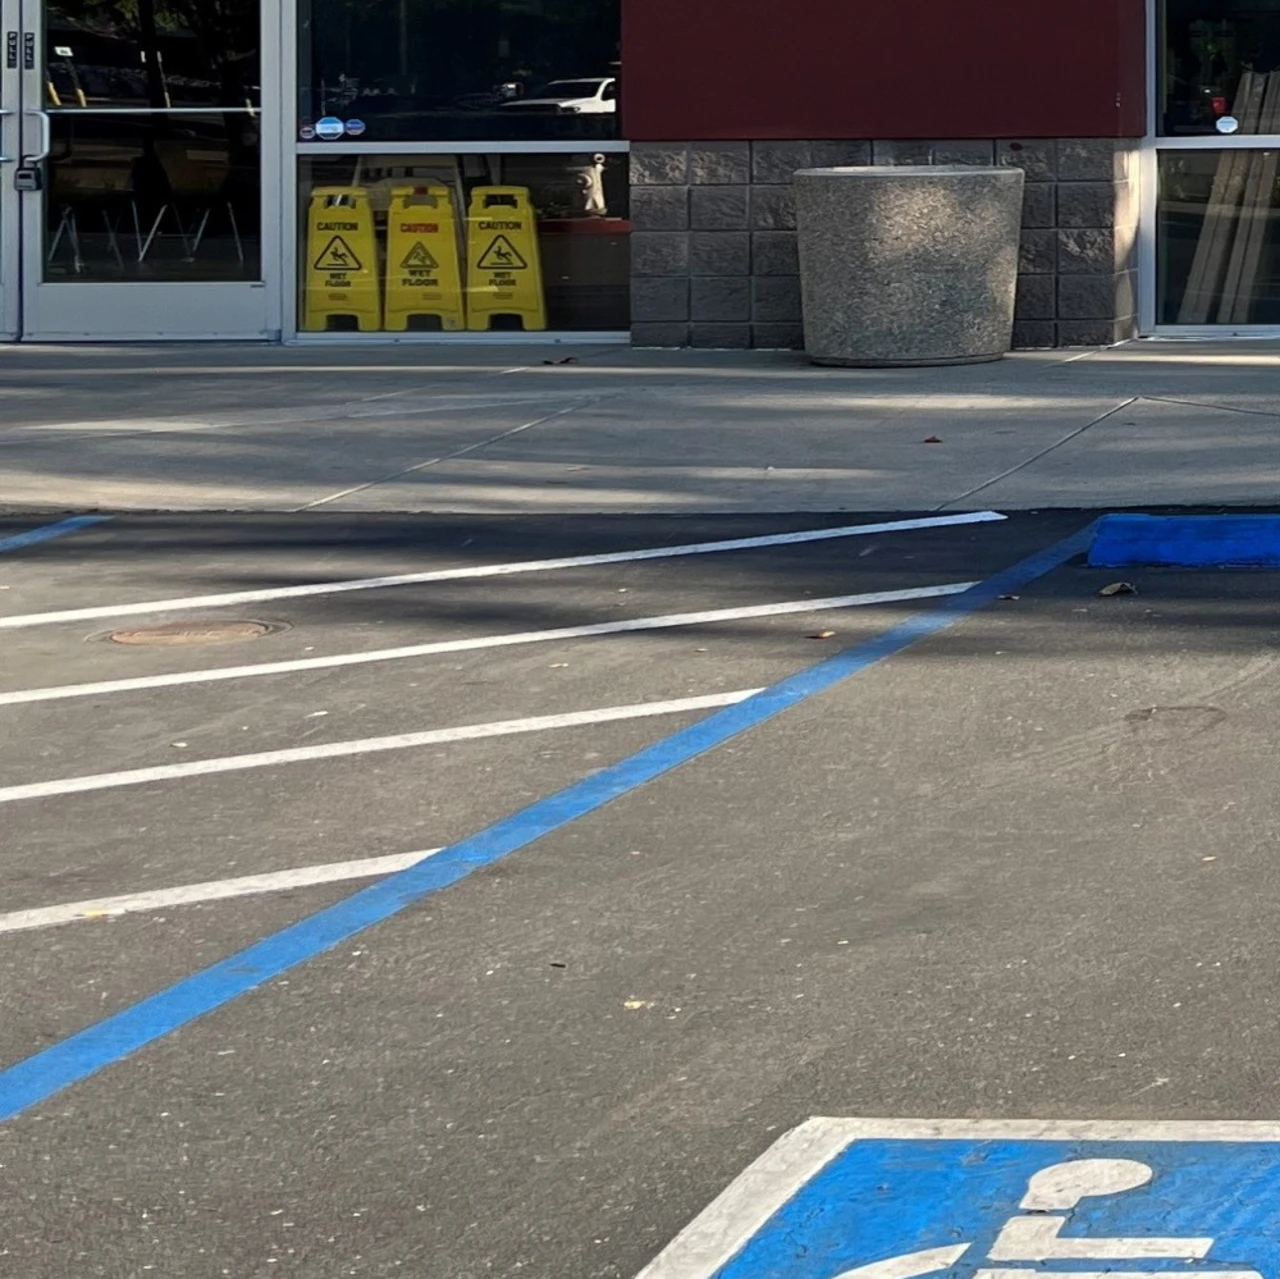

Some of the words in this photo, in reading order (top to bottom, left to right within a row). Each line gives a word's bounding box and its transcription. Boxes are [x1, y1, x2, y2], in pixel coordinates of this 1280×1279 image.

[317, 222, 359, 231] CAUTION
[400, 223, 439, 233] CAUTION
[478, 221, 521, 230] CAUTION
[408, 269, 431, 277] WET
[402, 278, 438, 286] FLOOR
